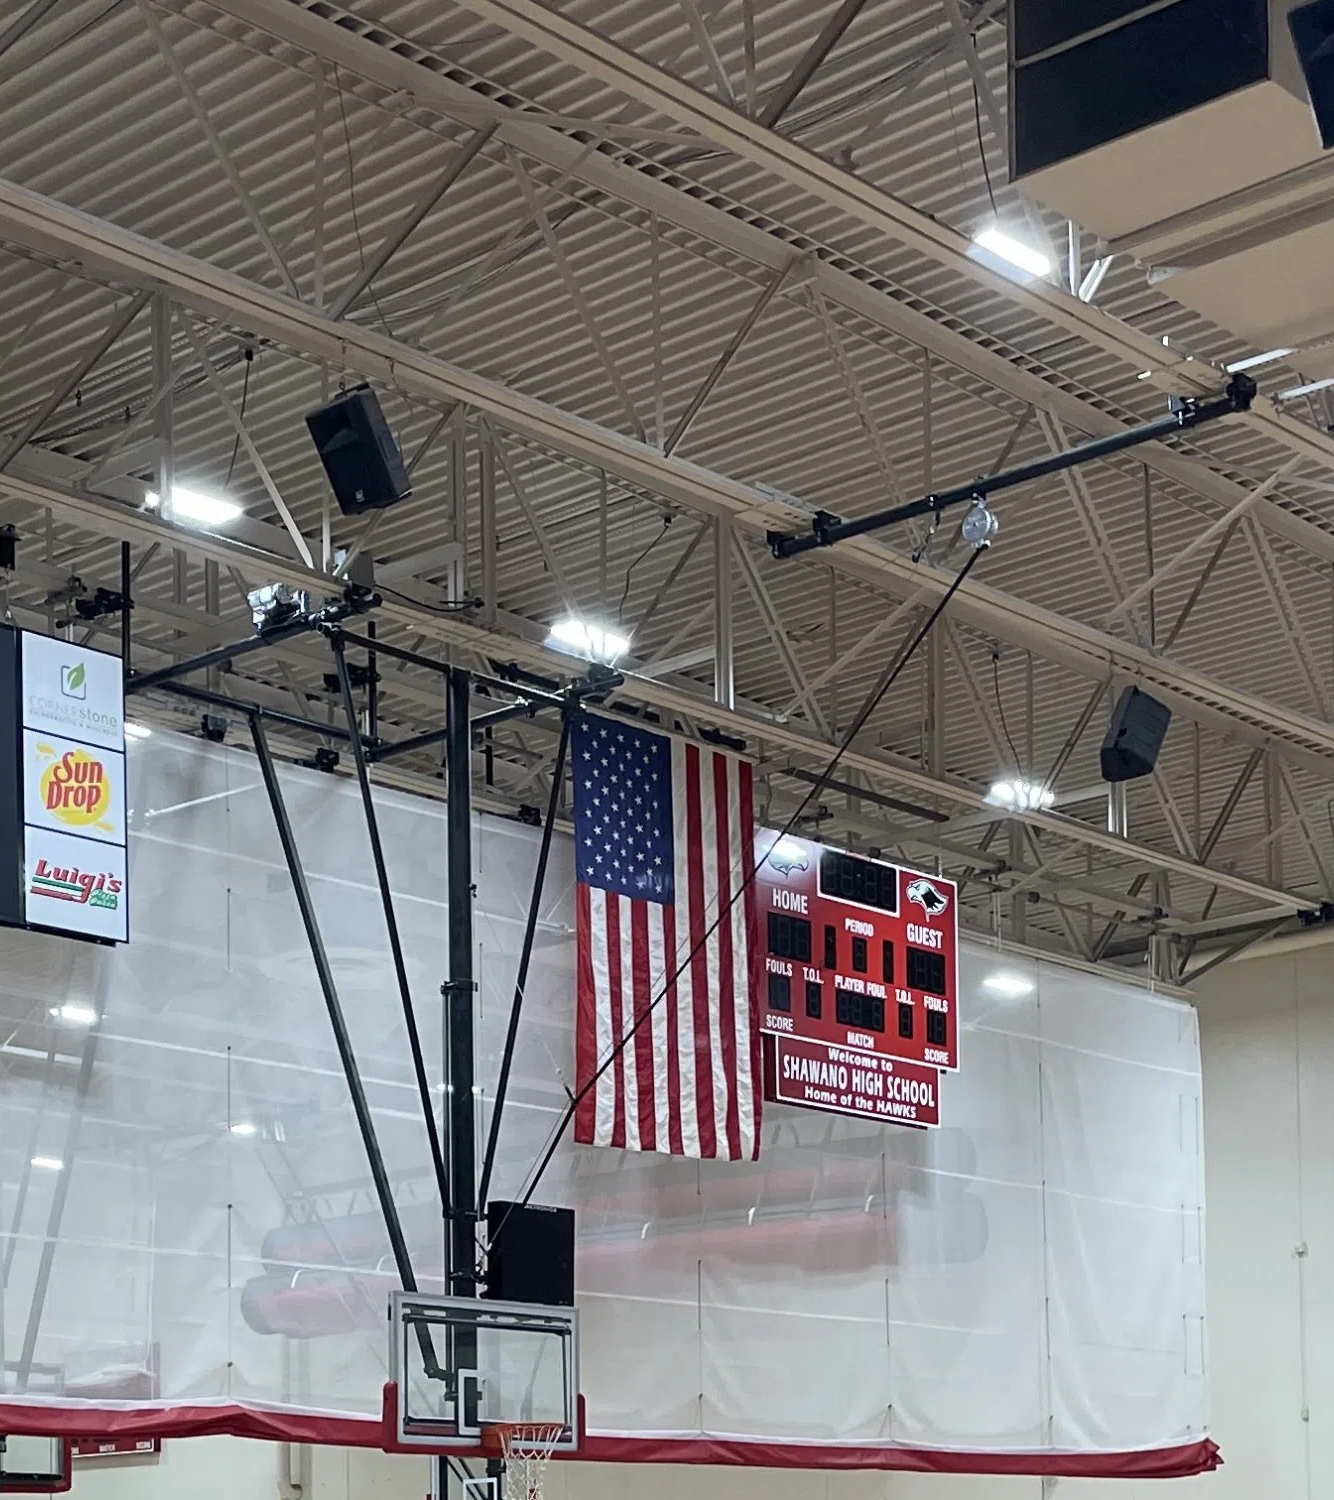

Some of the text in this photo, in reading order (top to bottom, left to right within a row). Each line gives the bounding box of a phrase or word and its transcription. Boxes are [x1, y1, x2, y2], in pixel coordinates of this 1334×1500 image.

[53, 751, 103, 784] Sun
[46, 780, 101, 813] Drop
[35, 859, 122, 903] Luigi's
[772, 888, 808, 915] HOME
[845, 918, 874, 937] PERIOD
[906, 923, 943, 949] GUEST
[766, 958, 793, 977] FOULS
[803, 966, 824, 984] T.O.L.
[835, 975, 887, 999] PLAYER FOUL
[923, 995, 948, 1013] FOULS
[766, 1014, 793, 1032] SCORE
[847, 1031, 874, 1048] MATCH
[828, 1048, 893, 1072] Welcome to
[924, 1048, 949, 1064] SCORE
[783, 1055, 935, 1107] SHAWANO HIGH SCHOOL
[805, 1086, 916, 1118] Home of the HAWKS
